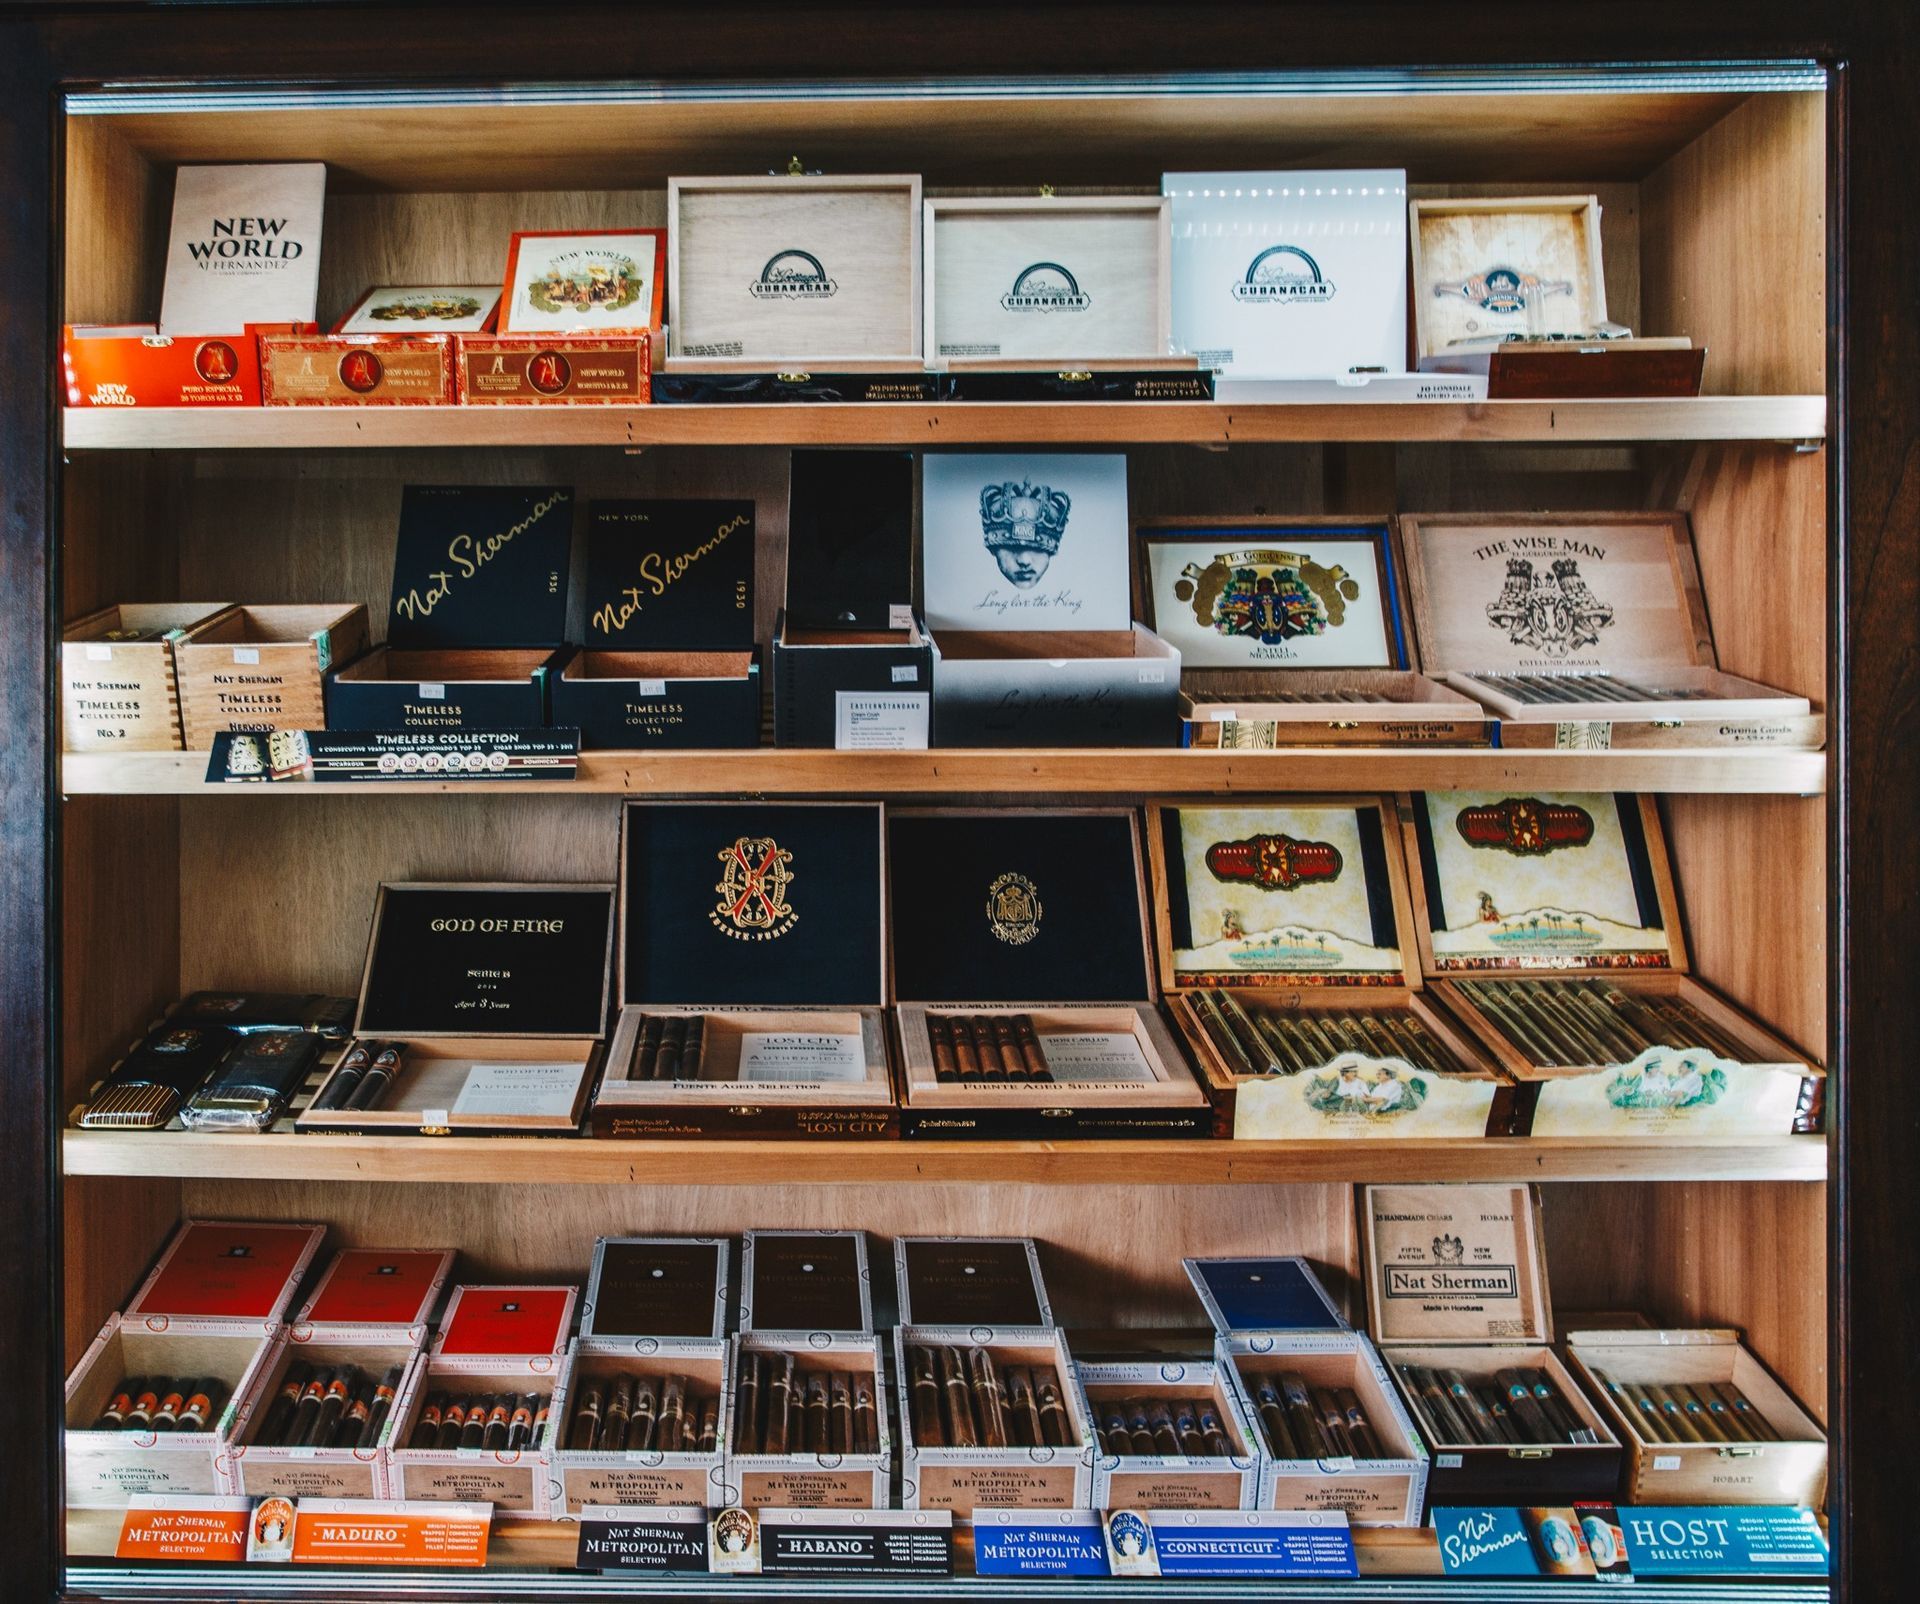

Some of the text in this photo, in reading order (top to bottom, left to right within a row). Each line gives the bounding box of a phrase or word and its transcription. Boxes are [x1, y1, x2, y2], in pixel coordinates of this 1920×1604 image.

[213, 218, 288, 237] NEW
[188, 239, 303, 260] WORLD
[551, 250, 632, 265] NEW WORLD
[213, 260, 289, 271] FERNANDEZ
[757, 284, 830, 293] CUBANACAN
[1240, 286, 1327, 295] CUBANACAN
[1008, 297, 1083, 306] CUBANACAN
[385, 368, 431, 377] NEW WORLD
[599, 369, 625, 377] WORLD
[96, 383, 128, 394] NEW
[89, 394, 136, 406] WORLD
[1014, 526, 1034, 538] KING
[1473, 536, 1607, 561] THE WISE MAN
[397, 491, 568, 620] Nat Sherman
[593, 514, 750, 634] Nat Sherman
[549, 571, 558, 593] 1930
[736, 581, 745, 608] 1930
[974, 591, 1007, 614] Long
[1032, 594, 1050, 606] the
[1053, 591, 1082, 614] King
[214, 675, 283, 684] NAT SHERMAN
[72, 681, 141, 690] NAT SHERMAN
[218, 693, 282, 704] TIMELESS
[77, 700, 140, 710] TIMELESS
[404, 705, 462, 715] TIMELESS
[626, 704, 683, 713] TIMELESS
[405, 718, 462, 726] COLLECTION
[626, 717, 683, 725] COLLECTION
[1382, 723, 1454, 732] Corona Gorda
[376, 733, 519, 744] TIMELESS COLLECTION
[431, 919, 564, 933] GOD OF FIRE
[808, 1121, 886, 1132] LOST CITY
[1393, 1273, 1508, 1289] Nat Sherman
[607, 1473, 667, 1482] NAT SHERMAN
[991, 1470, 1030, 1479] SHERMAN
[1713, 1476, 1753, 1484] HOBART
[273, 1478, 344, 1486] METROPOLITAN
[433, 1480, 505, 1488] METROPOLITAN
[590, 1481, 684, 1490] METROPOLITAN
[768, 1481, 847, 1490] METROPOLITAN
[952, 1480, 1047, 1488] METROPOLITAN
[1137, 1490, 1211, 1498] METROPOLITAN
[725, 1512, 742, 1520] NAT
[152, 1516, 227, 1529] NAT SHERMAN
[1112, 1521, 1145, 1535] SHERMAN
[1459, 1512, 1497, 1541] Nat
[128, 1528, 243, 1544] METROPOLITAN
[322, 1529, 398, 1541] MADURO
[608, 1527, 684, 1540] NAT SHERMAN
[1630, 1519, 1729, 1546] HOST
[1004, 1532, 1080, 1545] NAT SHERMAN
[586, 1540, 703, 1555] METROPOLITAN
[790, 1541, 862, 1552] HABANO
[984, 1545, 1102, 1559] METROPOLITAN
[1167, 1544, 1273, 1553] CONNECTICUT
[1444, 1531, 1528, 1568] Sherman
[621, 1556, 667, 1564] SELECTION
[1651, 1550, 1724, 1560] SELECTION
[1021, 1561, 1067, 1569] SELECTION
